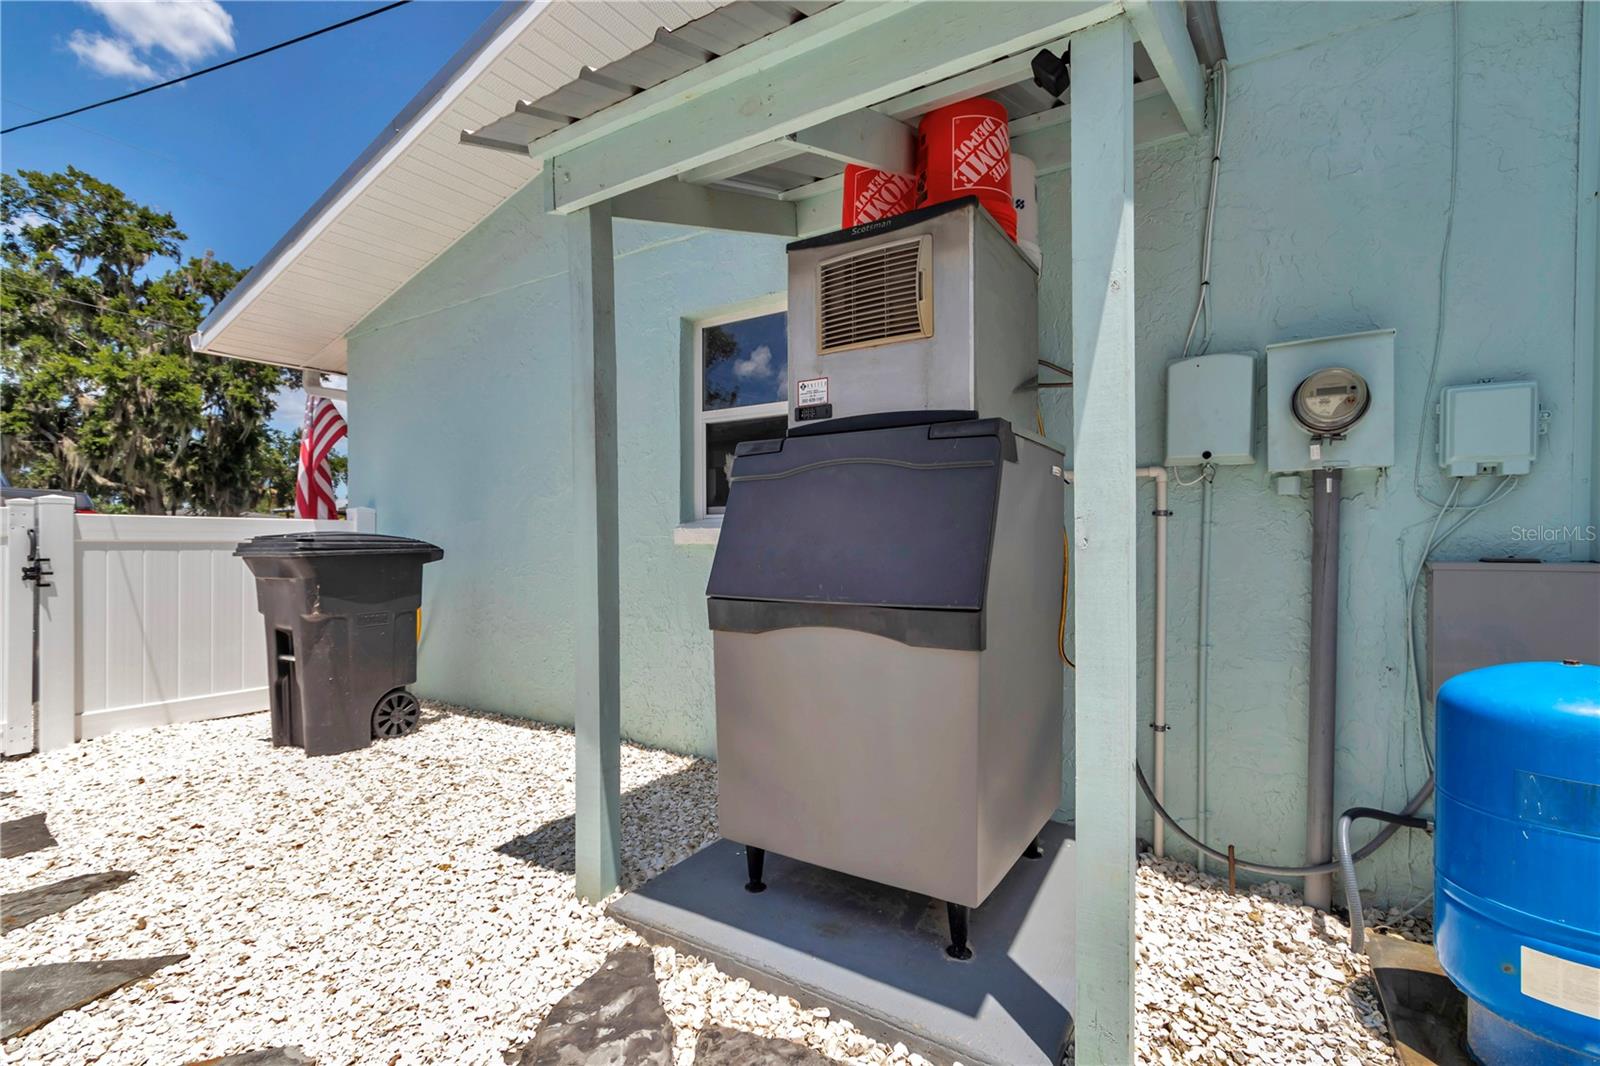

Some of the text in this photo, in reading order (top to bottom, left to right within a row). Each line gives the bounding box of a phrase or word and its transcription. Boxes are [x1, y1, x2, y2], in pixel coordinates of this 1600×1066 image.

[952, 122, 1010, 188] HOME
[954, 117, 996, 162] DEPOT
[989, 158, 1009, 183] THE
[851, 220, 892, 236] Scotsman
